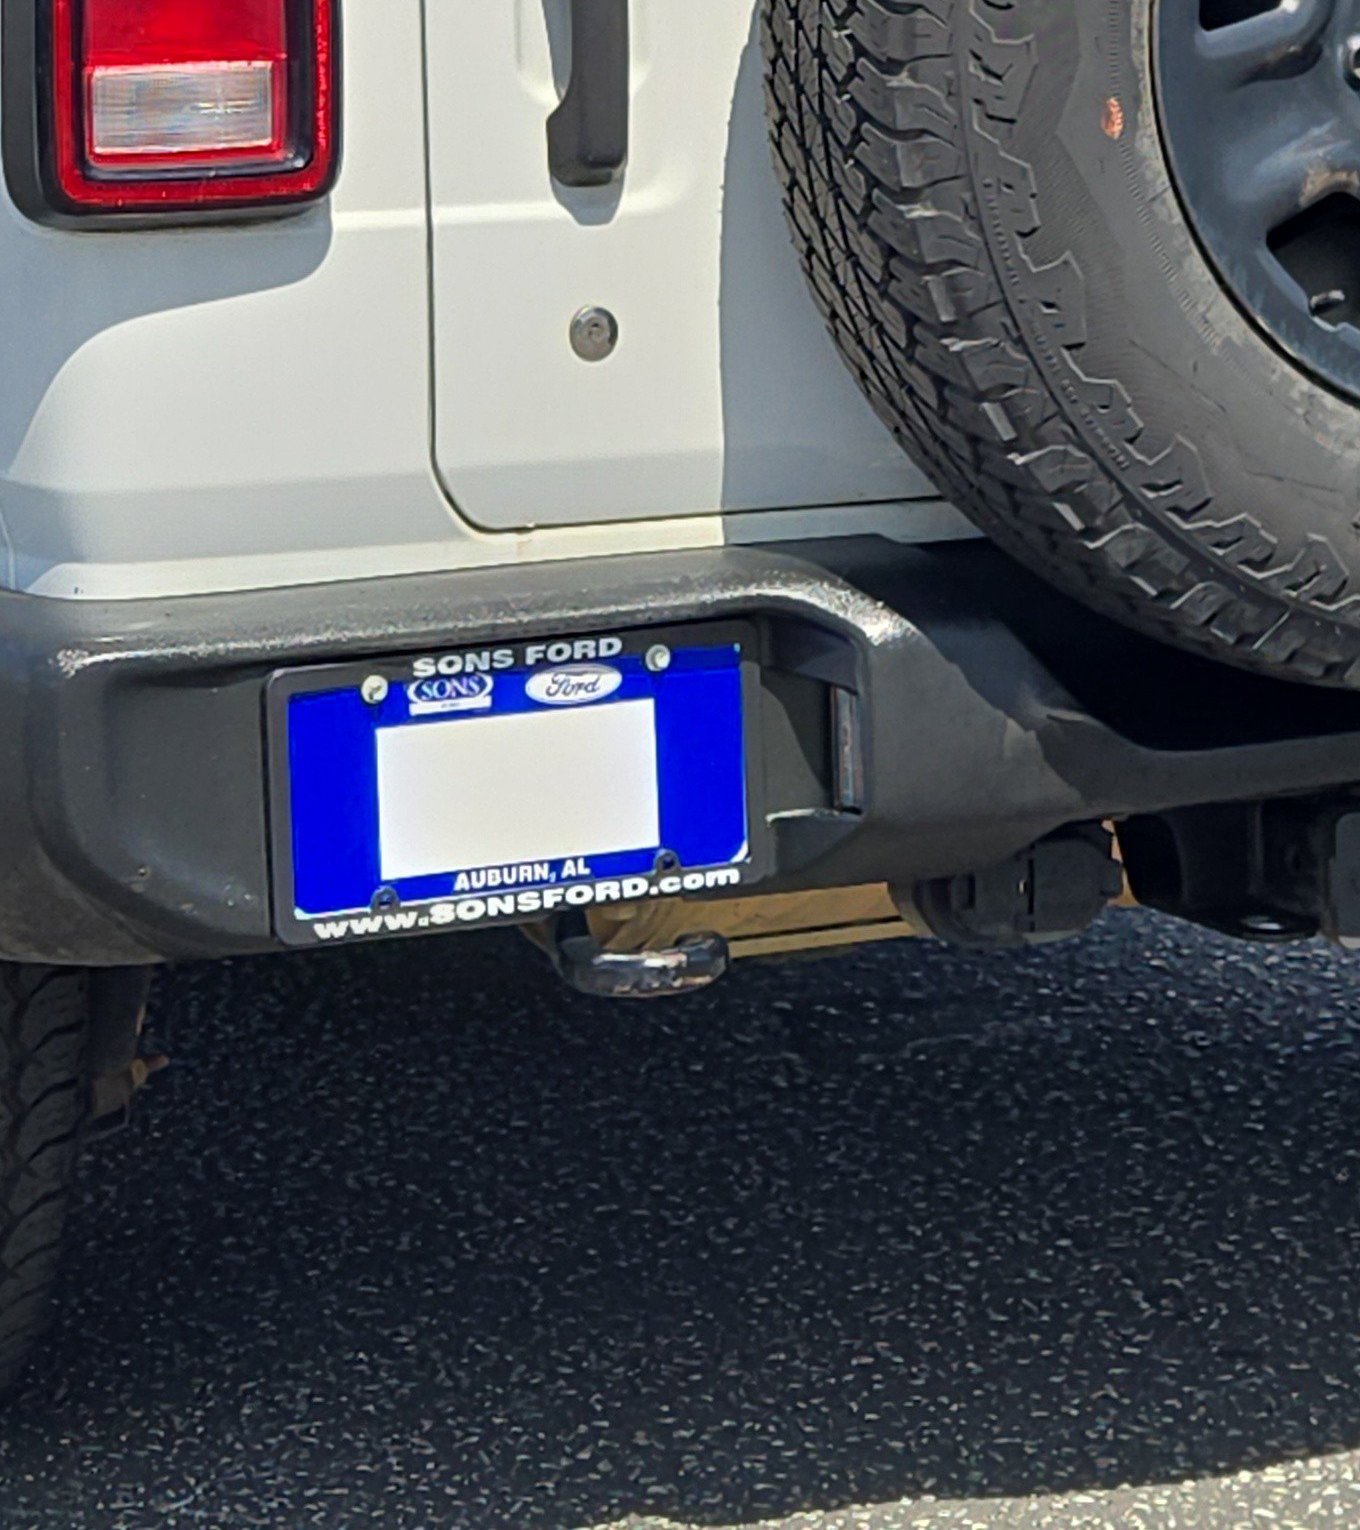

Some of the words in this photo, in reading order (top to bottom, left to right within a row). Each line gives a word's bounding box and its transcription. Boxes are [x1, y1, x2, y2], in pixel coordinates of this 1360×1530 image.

[412, 649, 515, 678] SONS
[525, 636, 623, 666] FORD
[419, 674, 482, 702] SONS
[544, 672, 602, 698] Ford
[453, 862, 557, 892] AUBURN,
[561, 858, 591, 878] AL
[313, 868, 741, 941] www.SONSFORD.com
